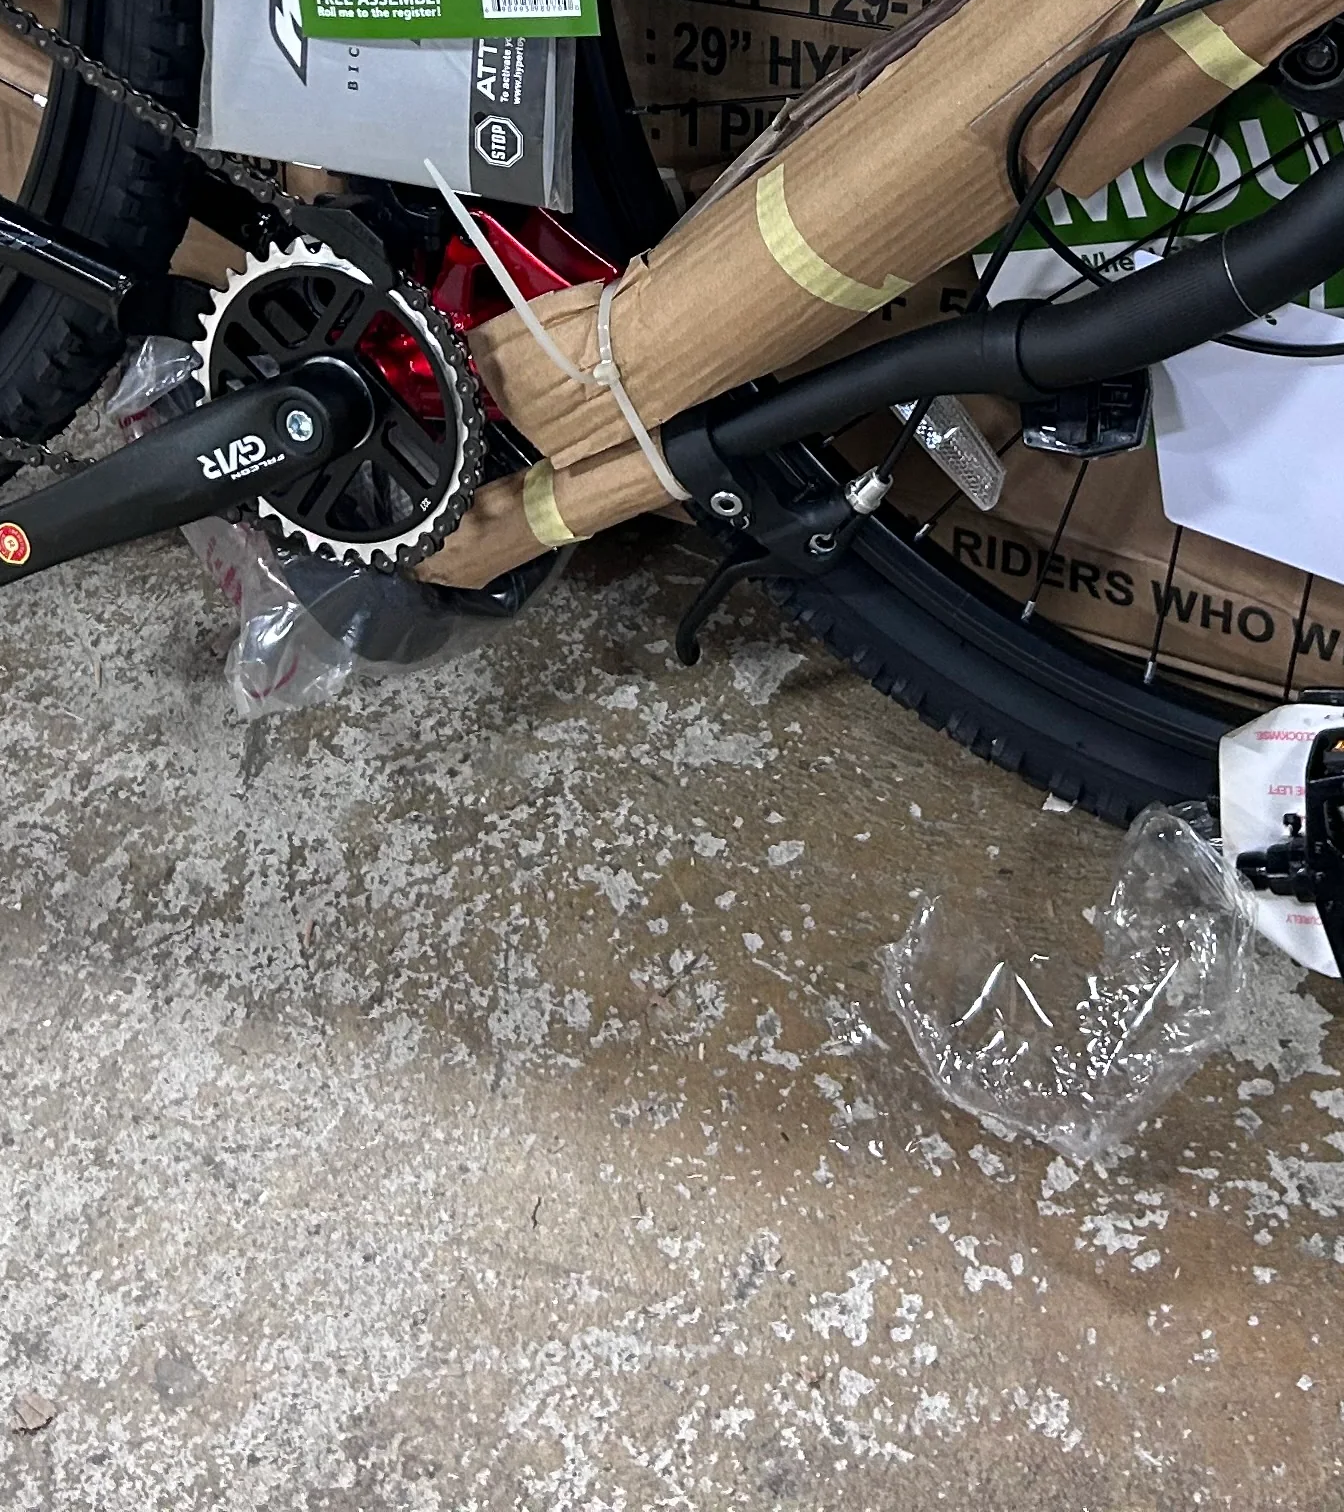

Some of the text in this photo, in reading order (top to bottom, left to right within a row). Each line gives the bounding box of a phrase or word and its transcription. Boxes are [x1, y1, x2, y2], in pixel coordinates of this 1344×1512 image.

[317, 6, 442, 21] Roll me to the register!
[491, 124, 506, 160] STOP
[952, 526, 1135, 608] RIDERS
[1154, 578, 1276, 644] WHO
[1268, 784, 1287, 796] LEFT
